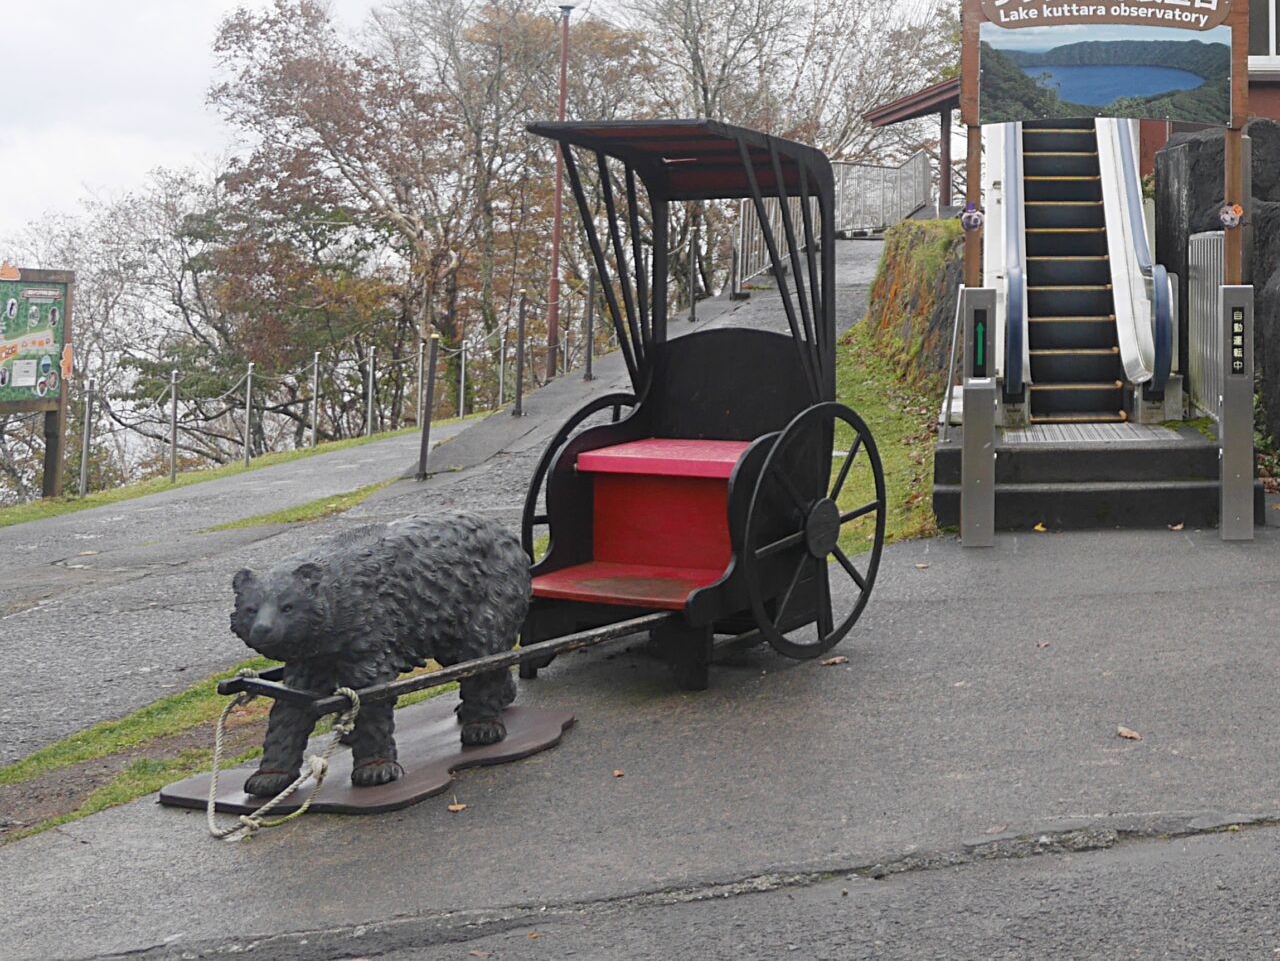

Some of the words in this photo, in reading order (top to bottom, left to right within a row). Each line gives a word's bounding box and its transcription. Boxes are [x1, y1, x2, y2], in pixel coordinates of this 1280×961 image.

[1000, 4, 1038, 23] Lake
[1043, 3, 1106, 18] kuttara
[1111, 3, 1209, 27] observatory
